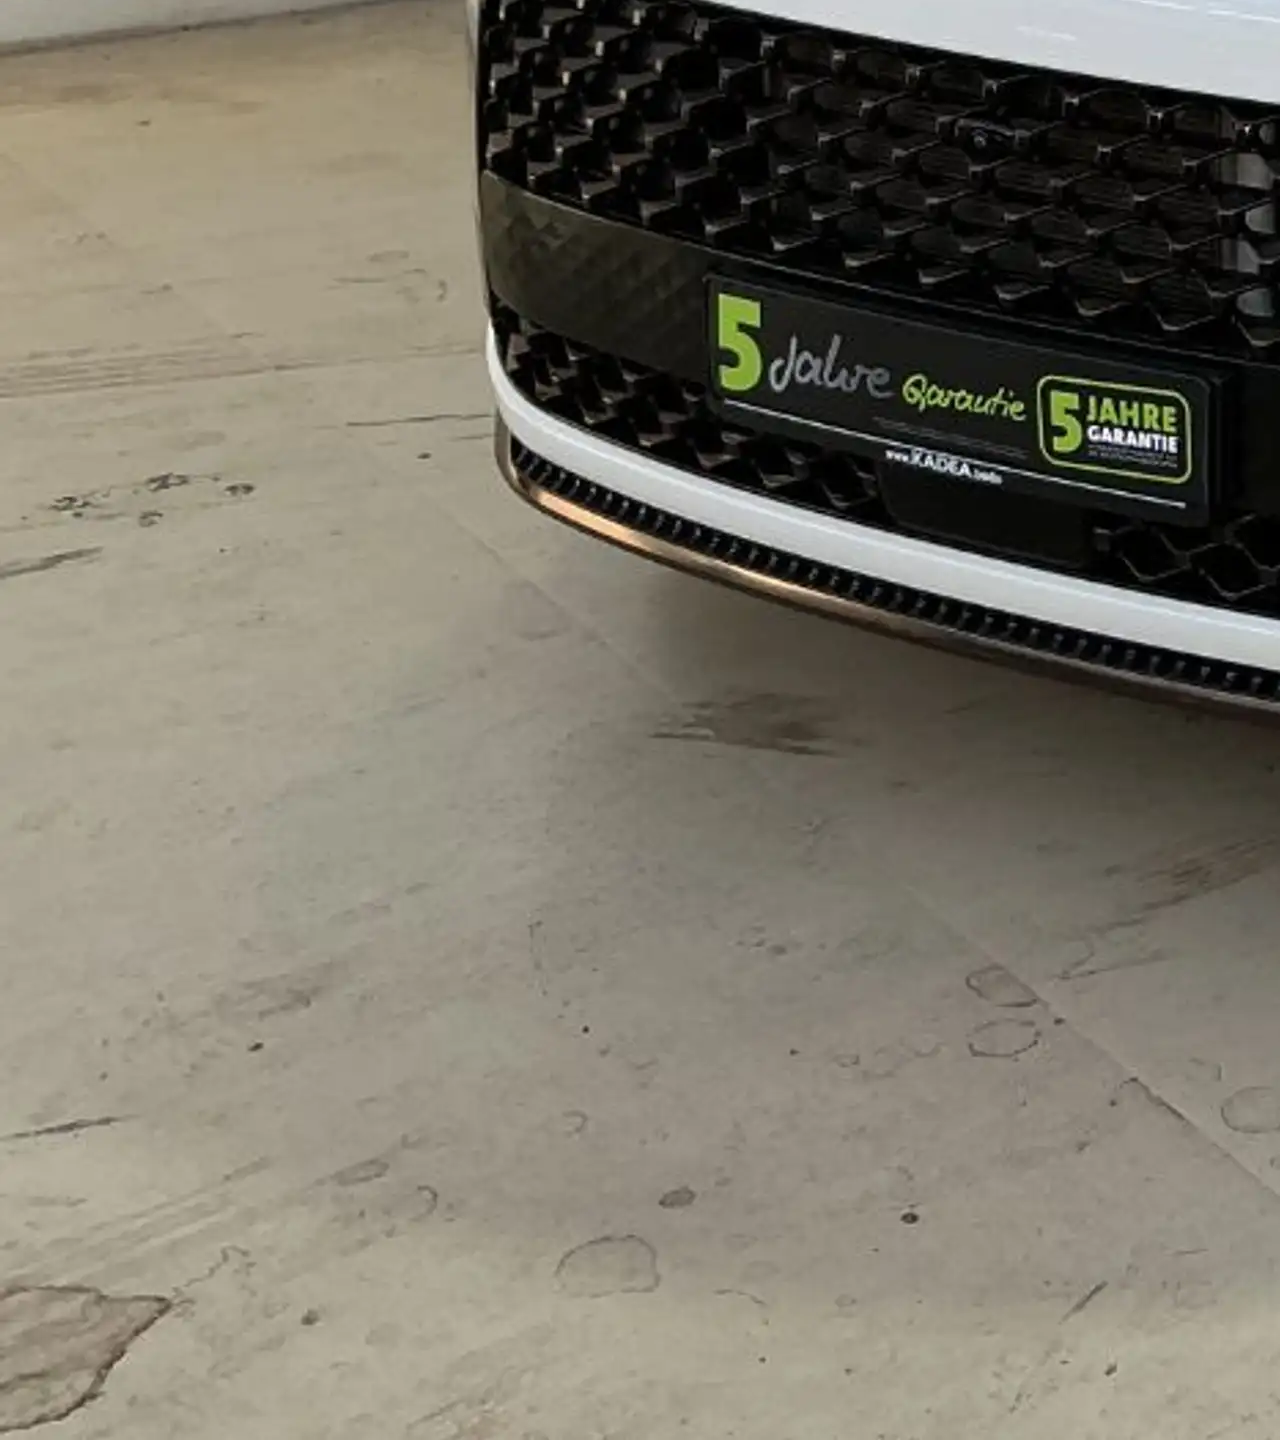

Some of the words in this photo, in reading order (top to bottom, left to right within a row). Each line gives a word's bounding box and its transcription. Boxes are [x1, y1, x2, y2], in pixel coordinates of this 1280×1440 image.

[718, 293, 764, 392] 5
[768, 333, 896, 398] Jahre
[902, 373, 1027, 422] Garantie
[1050, 389, 1082, 453] 5
[1086, 395, 1178, 433] JAHRE
[1086, 425, 1180, 454] GARANTIE
